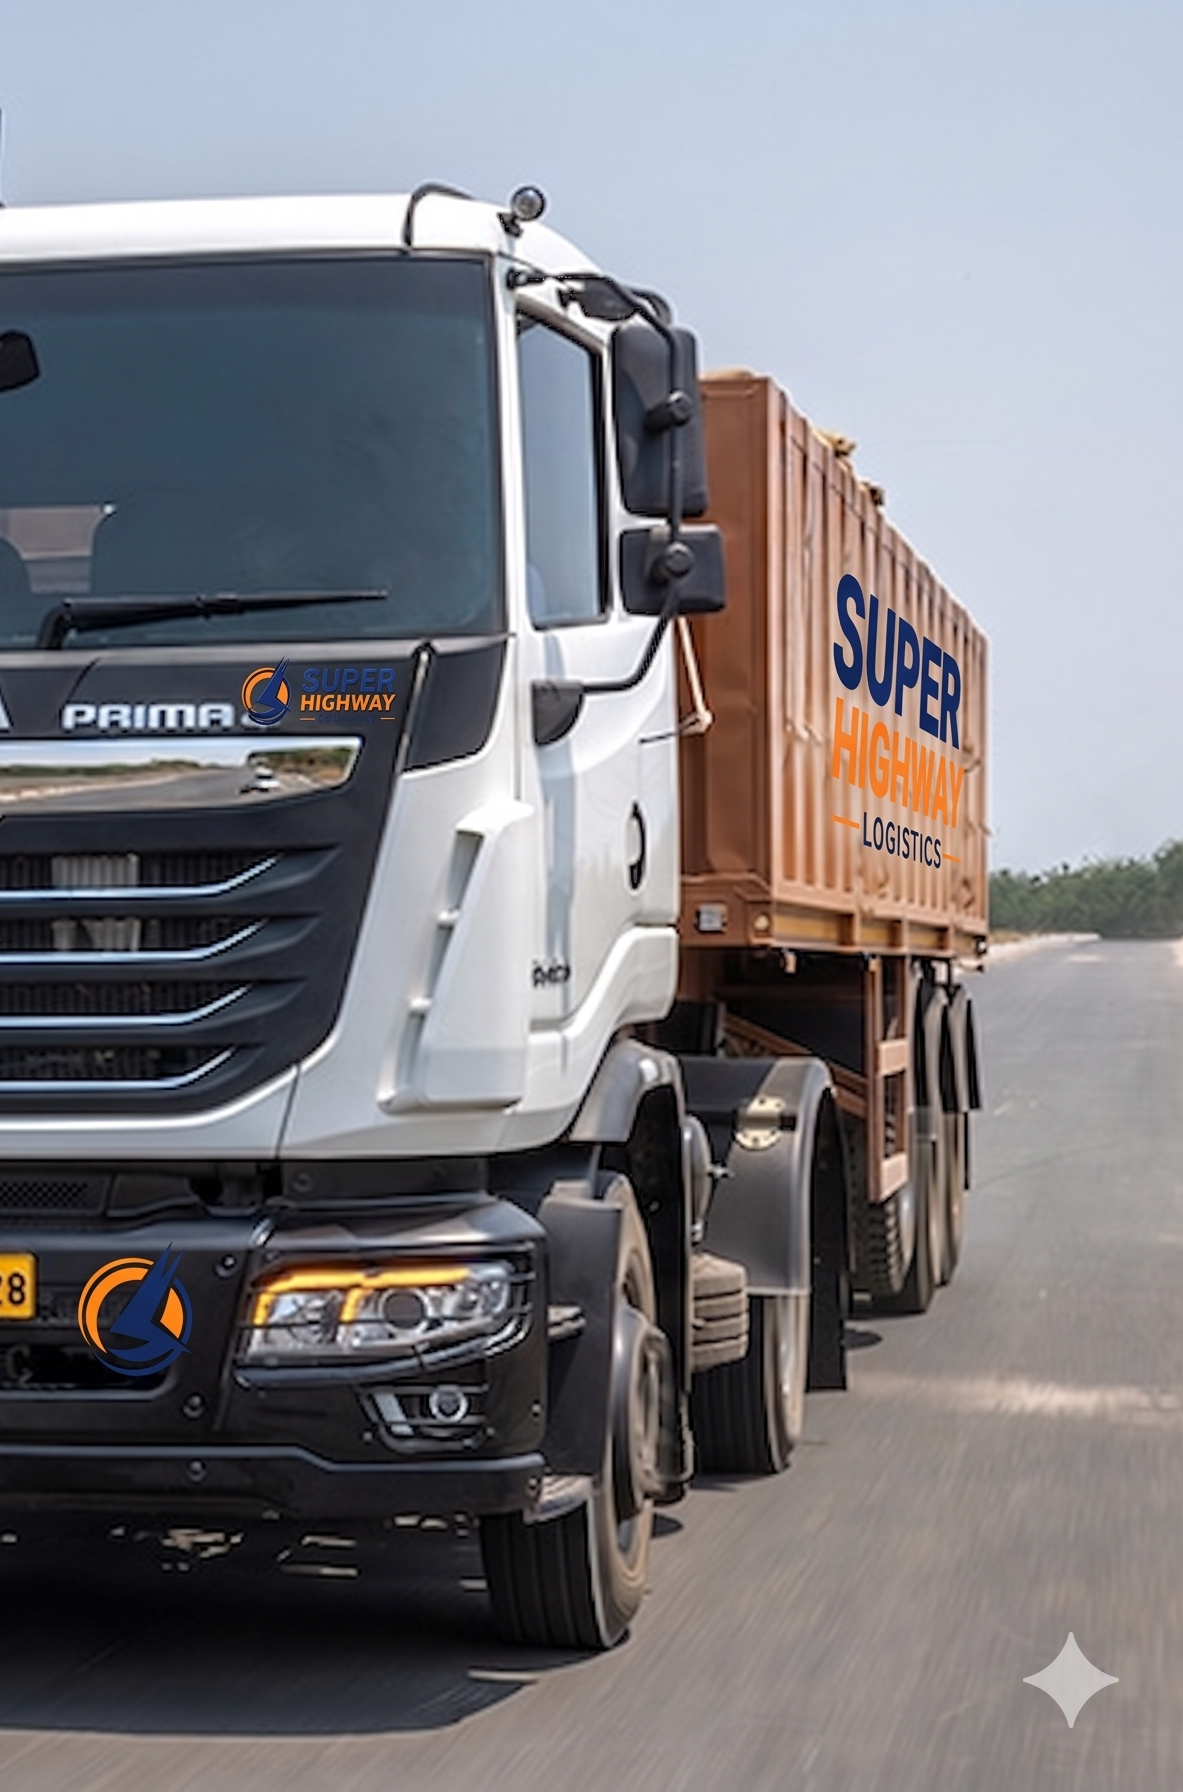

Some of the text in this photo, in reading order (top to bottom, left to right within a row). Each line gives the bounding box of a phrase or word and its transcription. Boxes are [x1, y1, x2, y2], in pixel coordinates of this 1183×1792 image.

[301, 667, 396, 693] SUPER
[833, 573, 961, 750] SUPER
[62, 703, 235, 730] PRIMA
[299, 693, 397, 712] HIGHWAY
[831, 696, 965, 829] HIGHWAY
[862, 811, 942, 869] LOGISTICS
